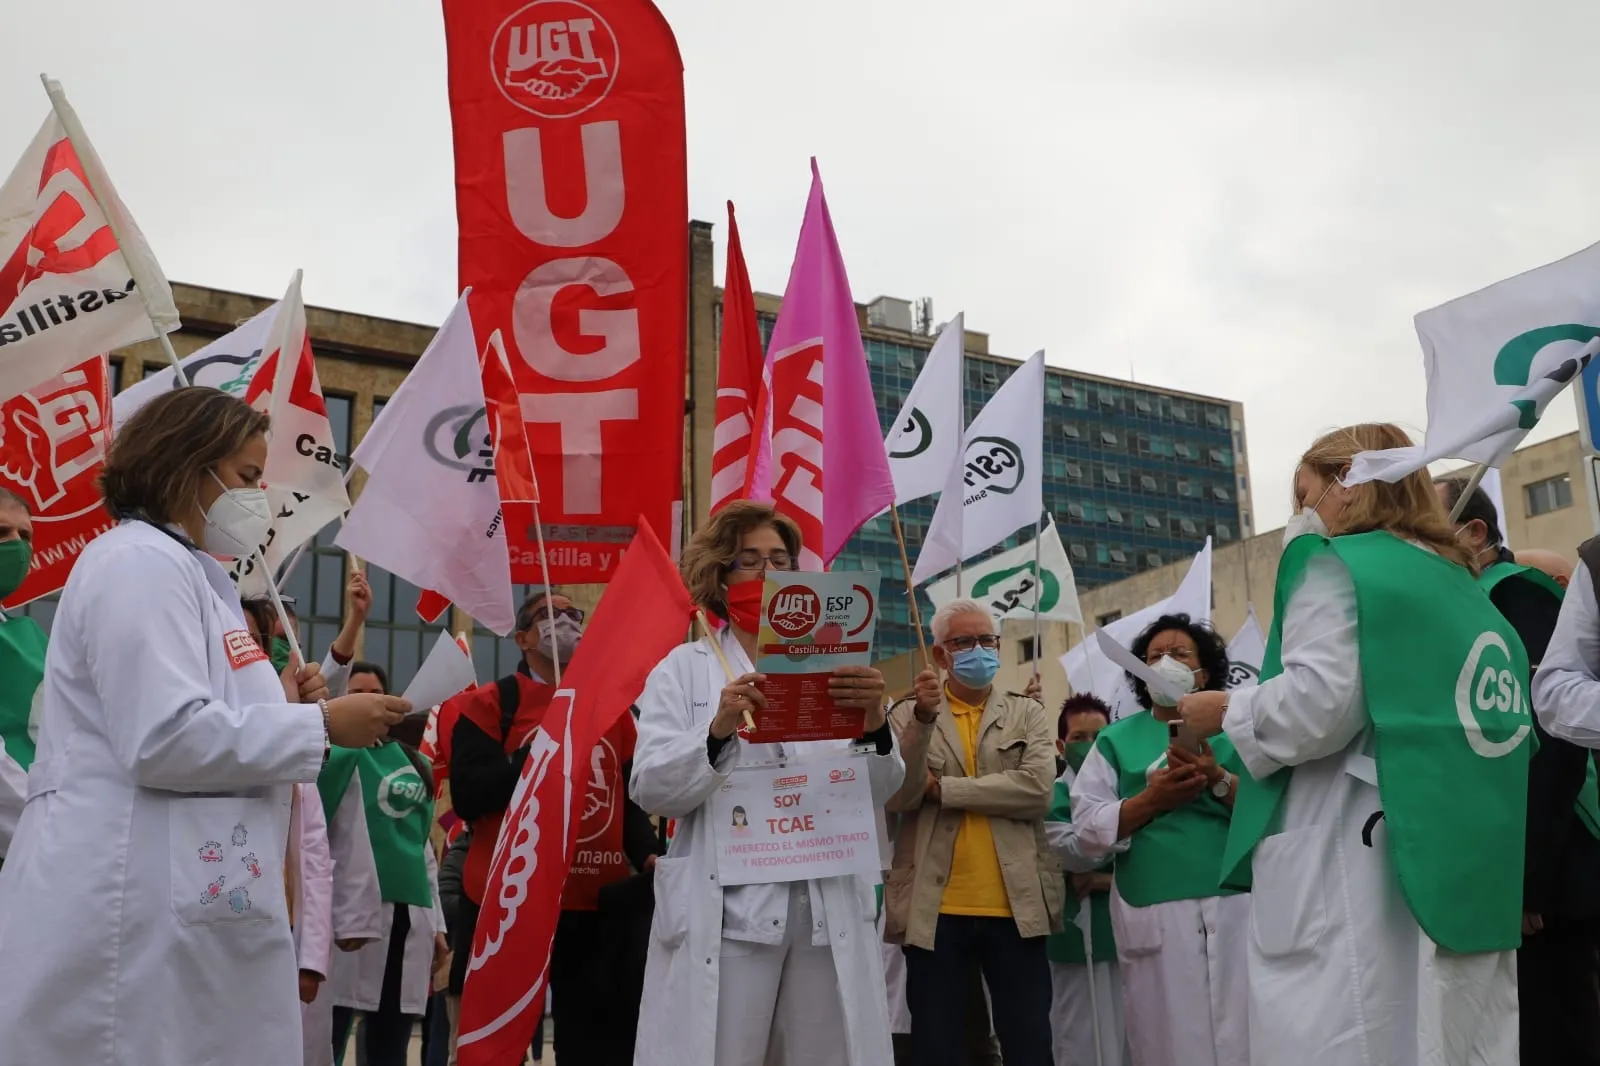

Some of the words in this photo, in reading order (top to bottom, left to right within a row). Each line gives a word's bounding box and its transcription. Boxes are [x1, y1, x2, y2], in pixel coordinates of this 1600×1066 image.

[507, 18, 597, 70] UGT
[503, 120, 642, 515] UGT
[599, 553, 612, 571] y
[775, 593, 815, 615] UGT
[788, 645, 819, 655] Castilla
[773, 794, 802, 808] SOY
[766, 815, 815, 834] TCAE
[783, 841, 794, 850] EL
[796, 837, 834, 848] MISMO
[837, 832, 870, 843] TRATO
[577, 850, 622, 865] mano
[742, 859, 748, 867] Y
[751, 850, 844, 867] RECONOCIMIENTO
